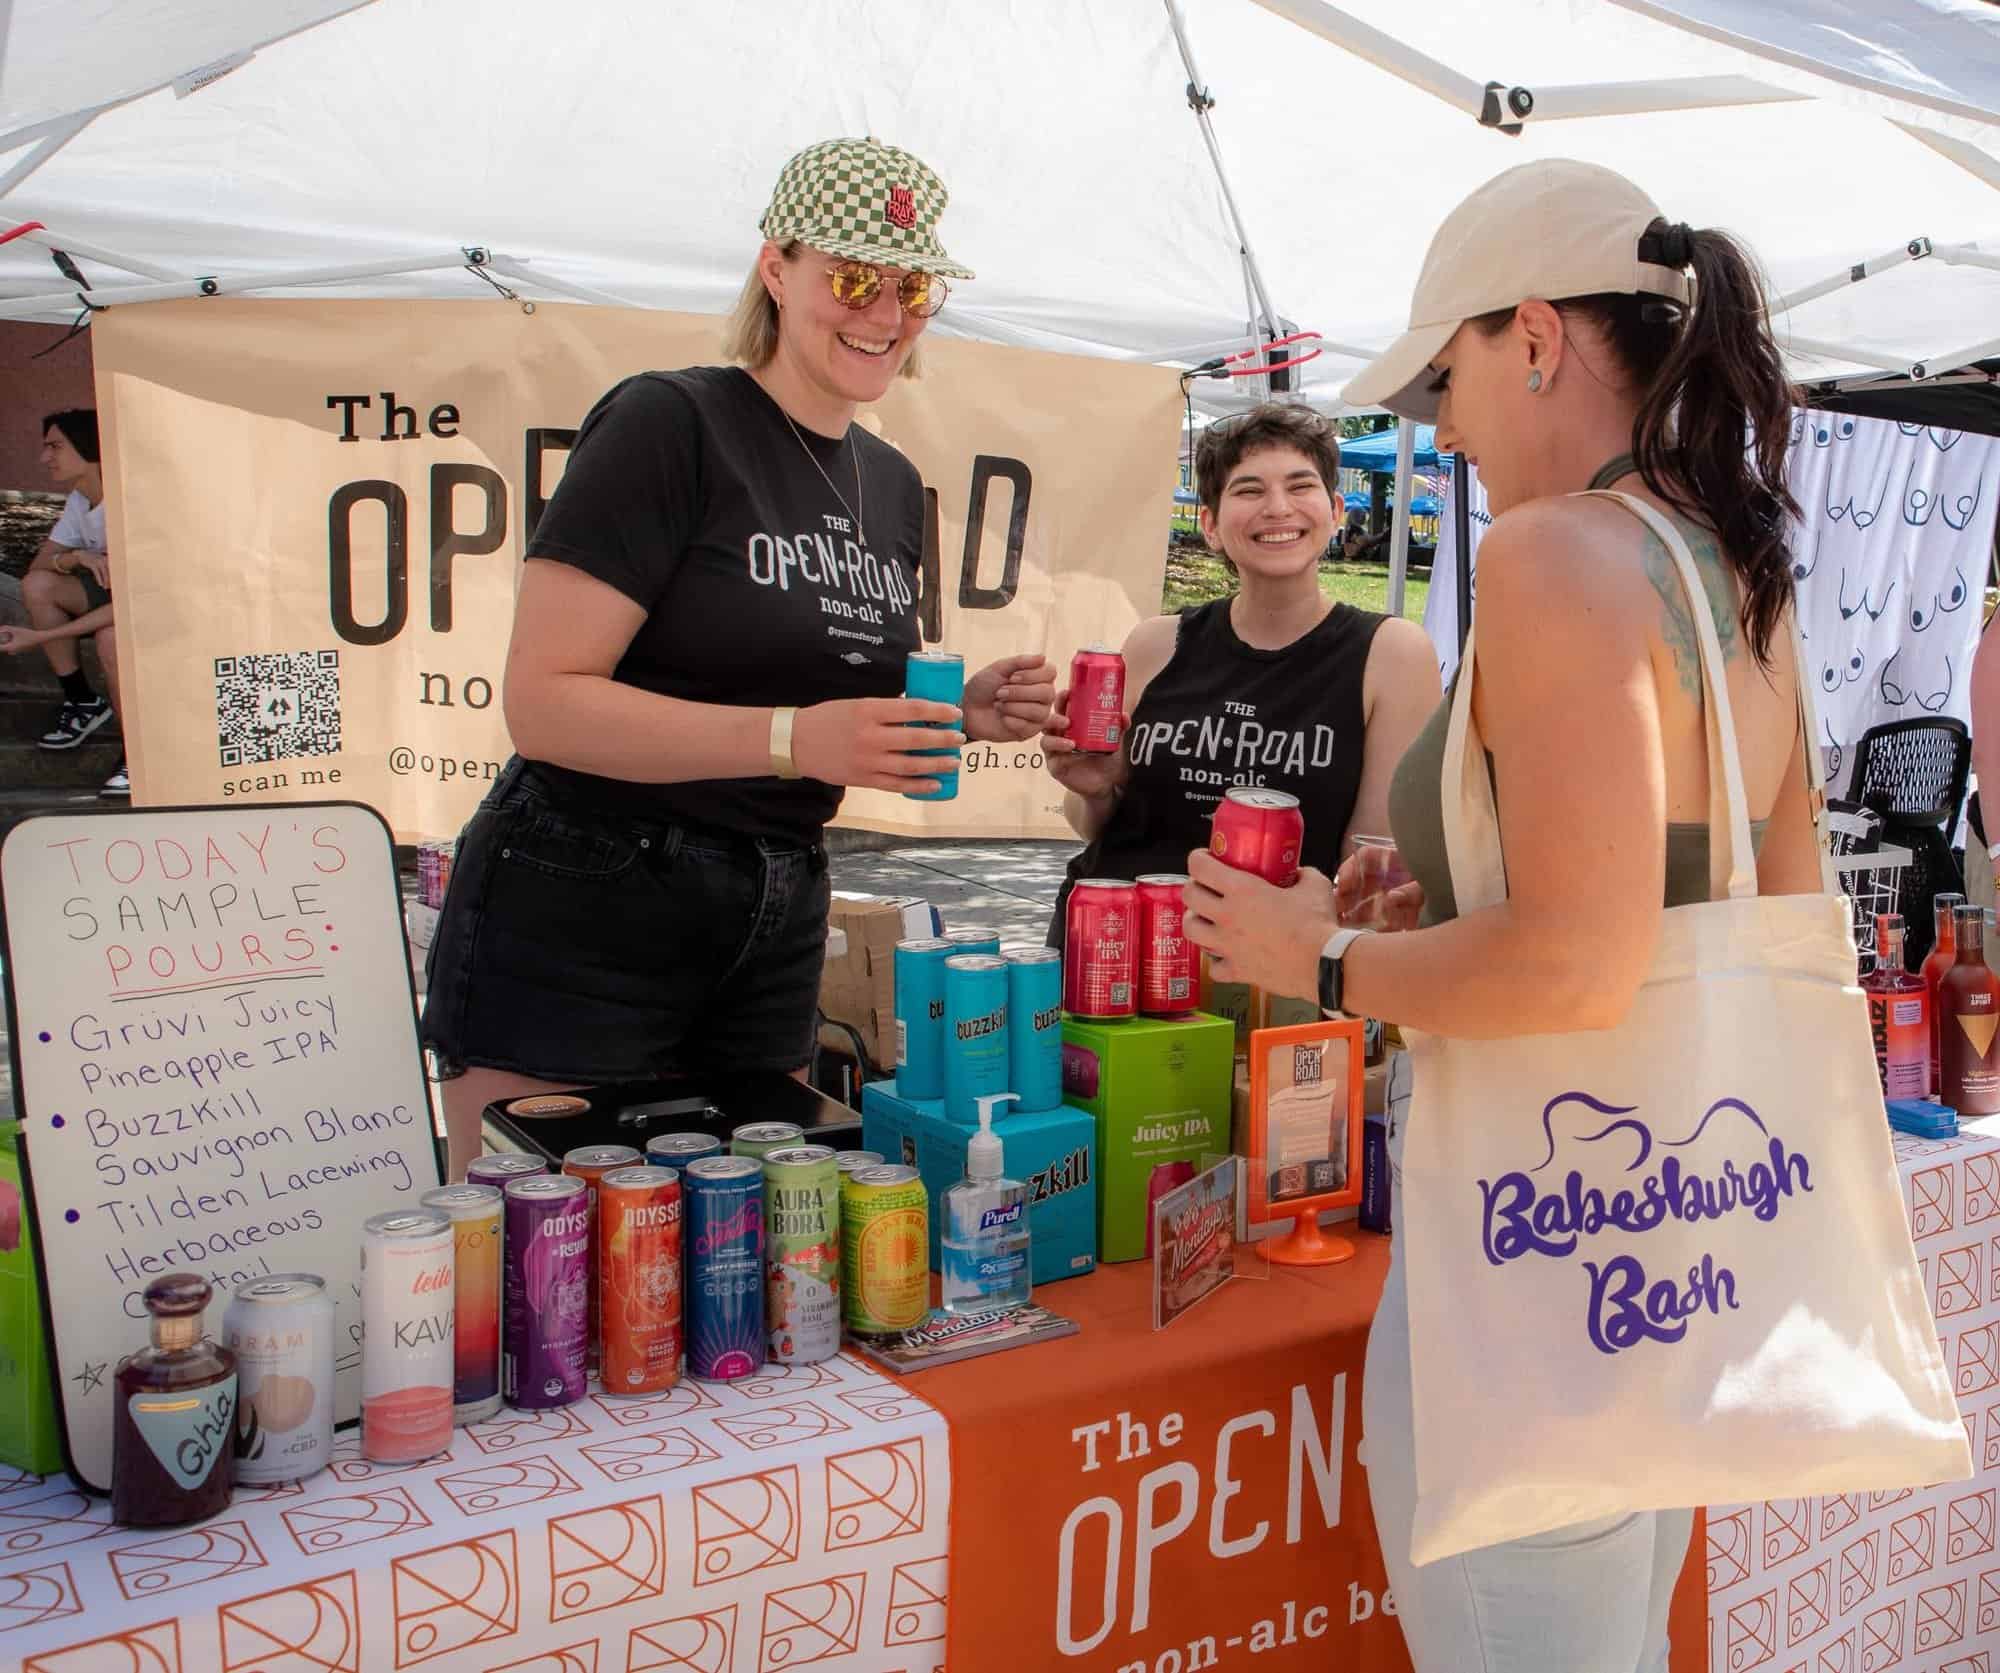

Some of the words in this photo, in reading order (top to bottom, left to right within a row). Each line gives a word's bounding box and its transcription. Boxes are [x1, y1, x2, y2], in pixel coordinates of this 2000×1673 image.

[327, 393, 460, 442] The
[823, 515, 850, 533] THE
[820, 596, 884, 625] non-alc
[1225, 701, 1256, 717] THE
[223, 769, 288, 797] scan
[300, 767, 343, 786] me
[388, 747, 502, 781] @open
[1179, 766, 1267, 787] non-alc
[46, 824, 346, 884] TODAY'S
[63, 882, 327, 940] SAMPLE
[105, 925, 340, 987] POURS:
[70, 1012, 206, 1052] Grüvi
[223, 990, 338, 1035] Juicy
[79, 1047, 255, 1095] Pineapple
[264, 1030, 337, 1066] IPA
[1296, 1049, 1321, 1067] OPEN
[1296, 1065, 1321, 1081] ROAD
[96, 1125, 294, 1185] Sauvignon
[305, 1104, 413, 1144] Blanc
[1132, 1120, 1181, 1144] Juicy
[1183, 1117, 1212, 1137] IPA
[97, 1184, 249, 1235] Tilden
[260, 1148, 413, 1200] Lacewing
[774, 1187, 824, 1211] AURA
[1031, 1144, 1090, 1205] zkill
[543, 1210, 588, 1238] ODYSS
[624, 1200, 682, 1227] ODYSSE
[774, 1212, 825, 1234] BORA
[983, 1205, 1022, 1226] Purell
[1477, 1136, 1813, 1265] Babesburgh
[105, 1208, 324, 1285] Herbaceous
[1581, 1252, 1740, 1354] Bash
[175, 1390, 233, 1477] Ghia
[1072, 1411, 1183, 1472] The
[1056, 1371, 1347, 1656] OPEN
